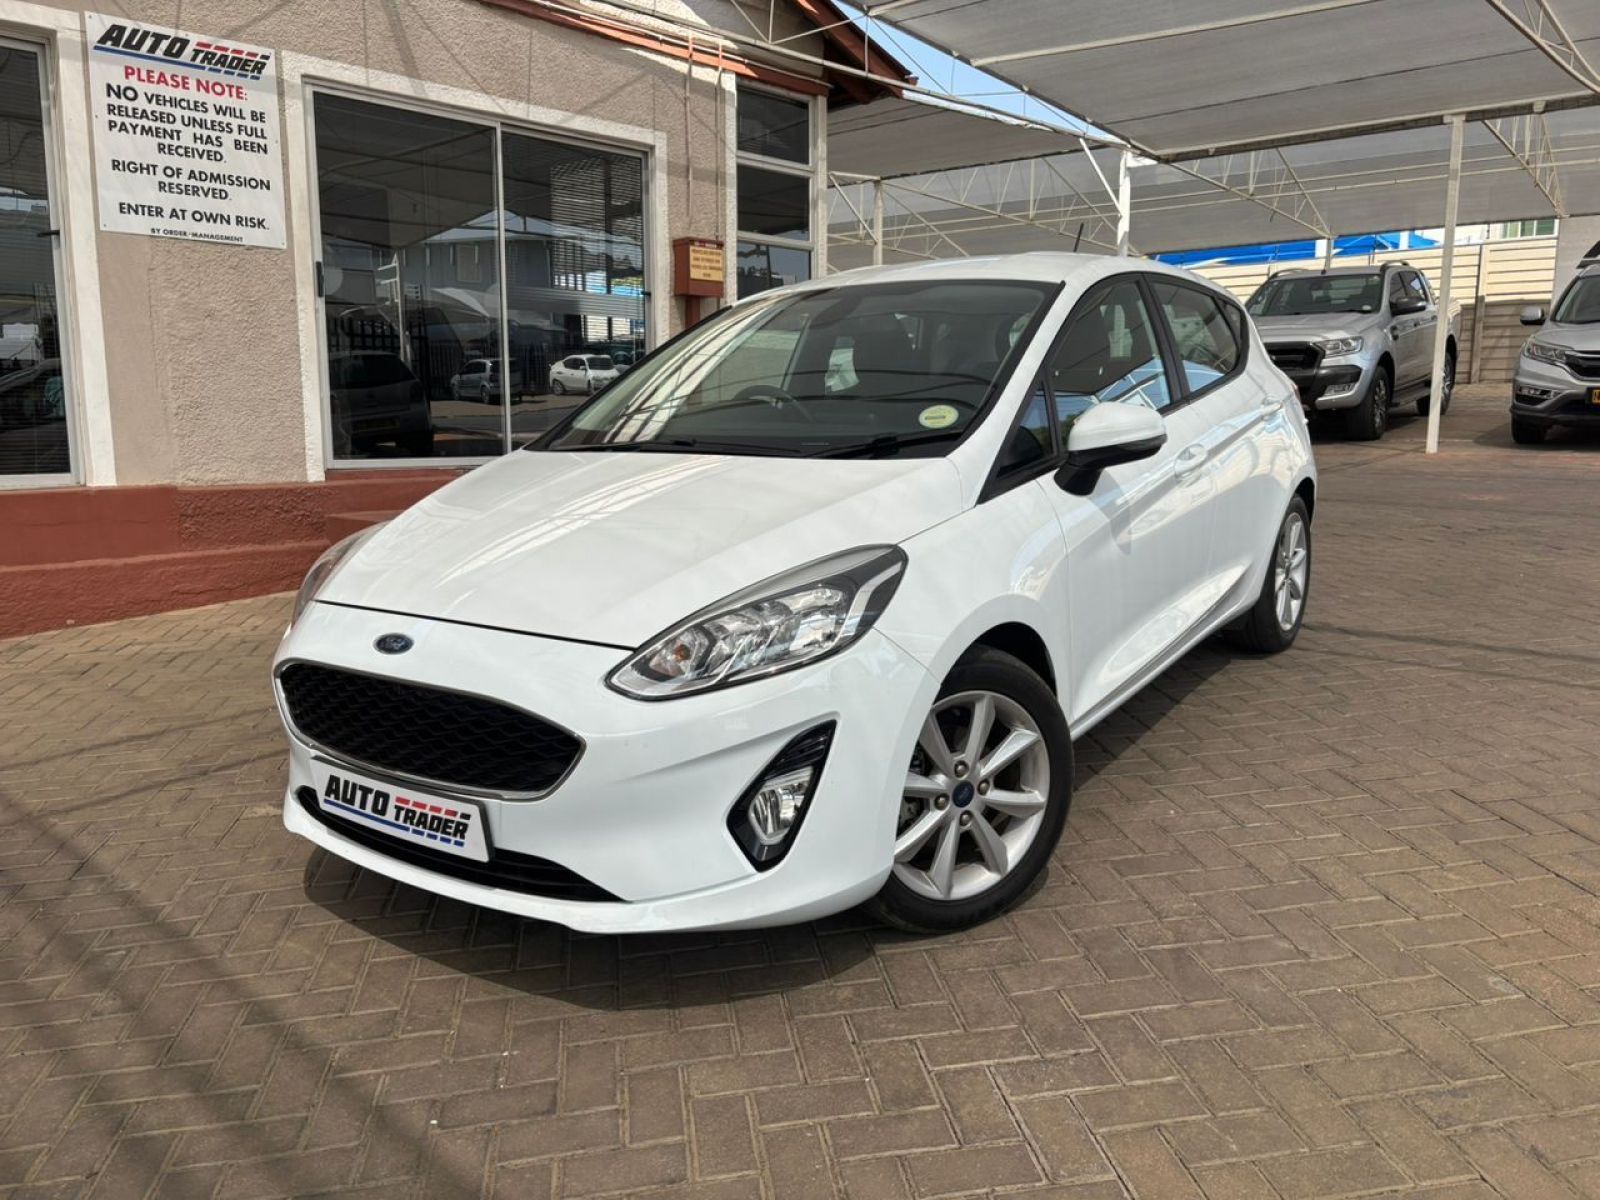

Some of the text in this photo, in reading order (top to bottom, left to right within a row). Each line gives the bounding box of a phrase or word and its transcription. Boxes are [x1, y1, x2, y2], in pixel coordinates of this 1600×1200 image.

[97, 24, 267, 75] AUTO TRADER
[124, 65, 248, 101] PLEASE NOTE:
[106, 83, 266, 123] NO VEHICLES WILL BE
[107, 103, 268, 139] RELEASED UNLESS FULL
[108, 119, 268, 154] PAYMENT HAS BEEN
[157, 142, 227, 163] RECEIVED.
[111, 159, 271, 191] RIGHT OF ADMISSION
[158, 181, 232, 201] RESERVED.
[119, 202, 270, 230] ENTER AT OWN RISK.
[324, 774, 469, 840] AUTO TRADER
